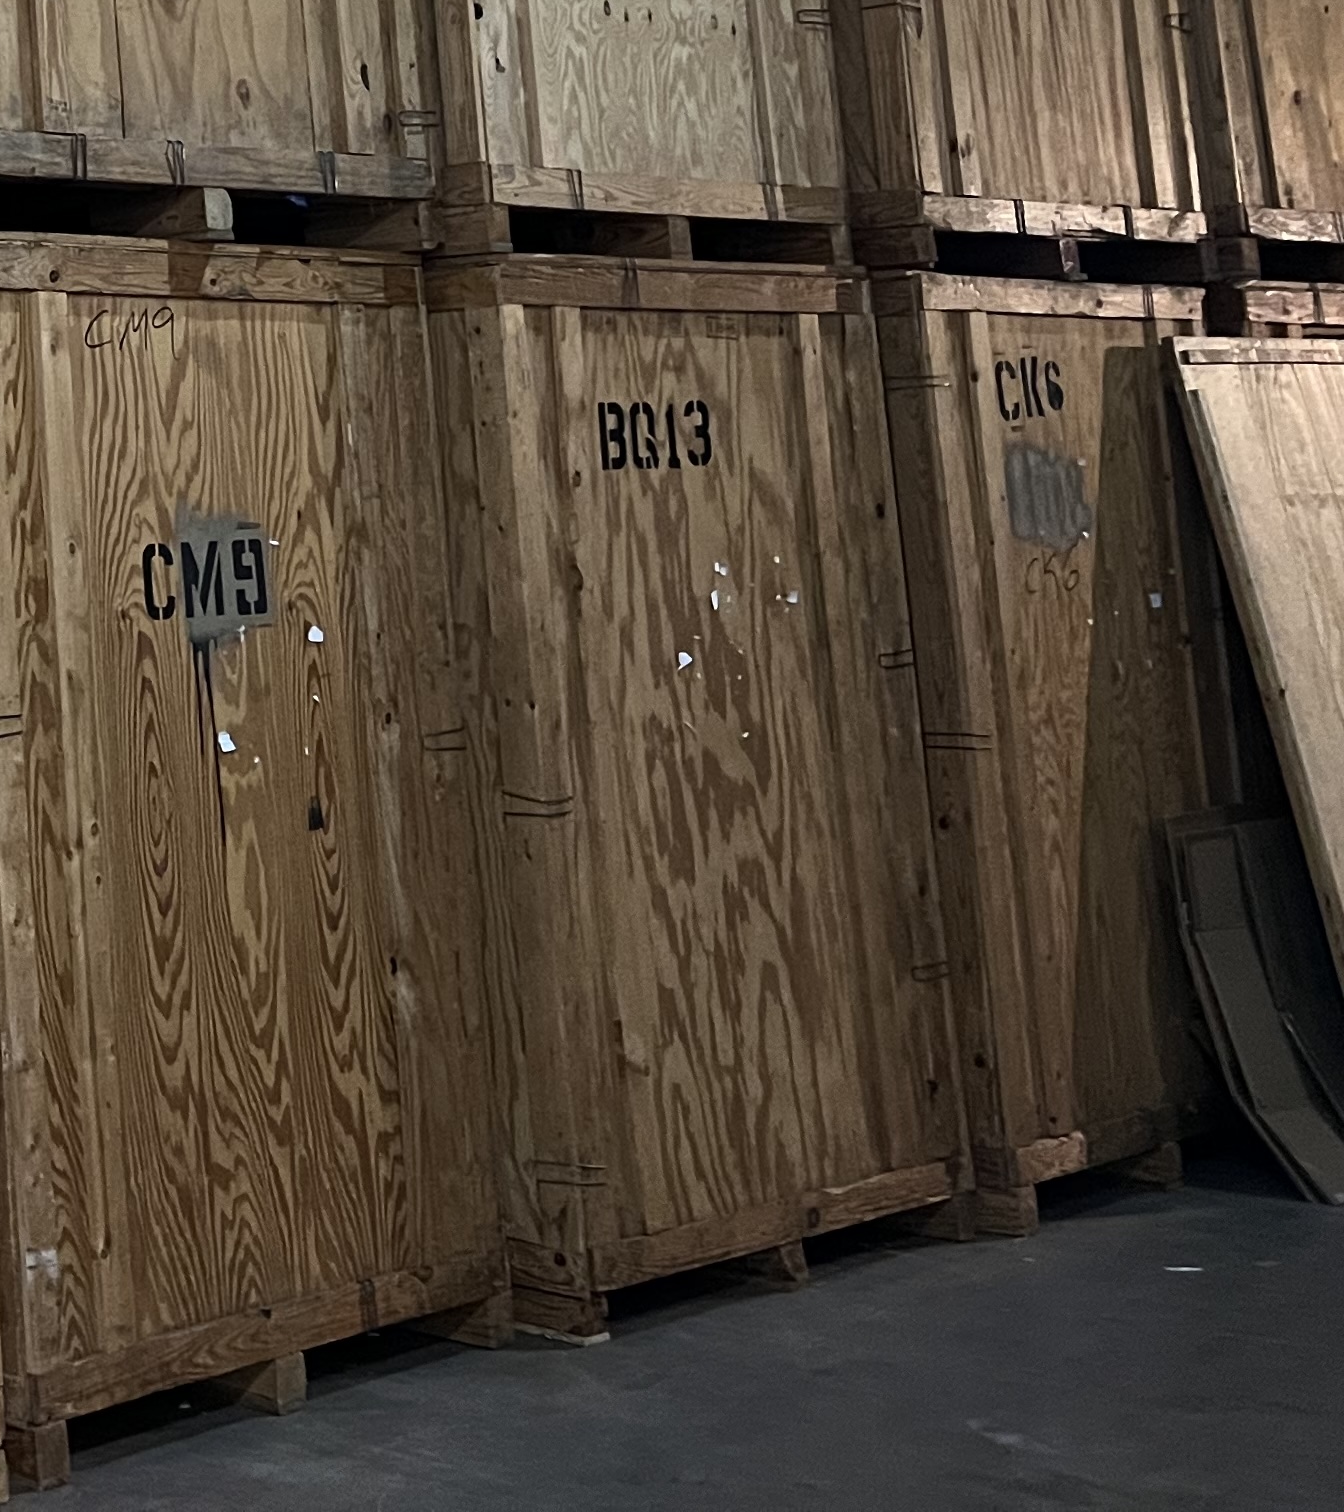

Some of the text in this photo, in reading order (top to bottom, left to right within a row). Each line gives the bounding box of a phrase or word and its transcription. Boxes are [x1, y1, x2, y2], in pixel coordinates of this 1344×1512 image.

[84, 306, 182, 361] CM9
[994, 355, 1064, 422] CK6
[597, 399, 713, 471] BQ13
[142, 538, 269, 621] CM9
